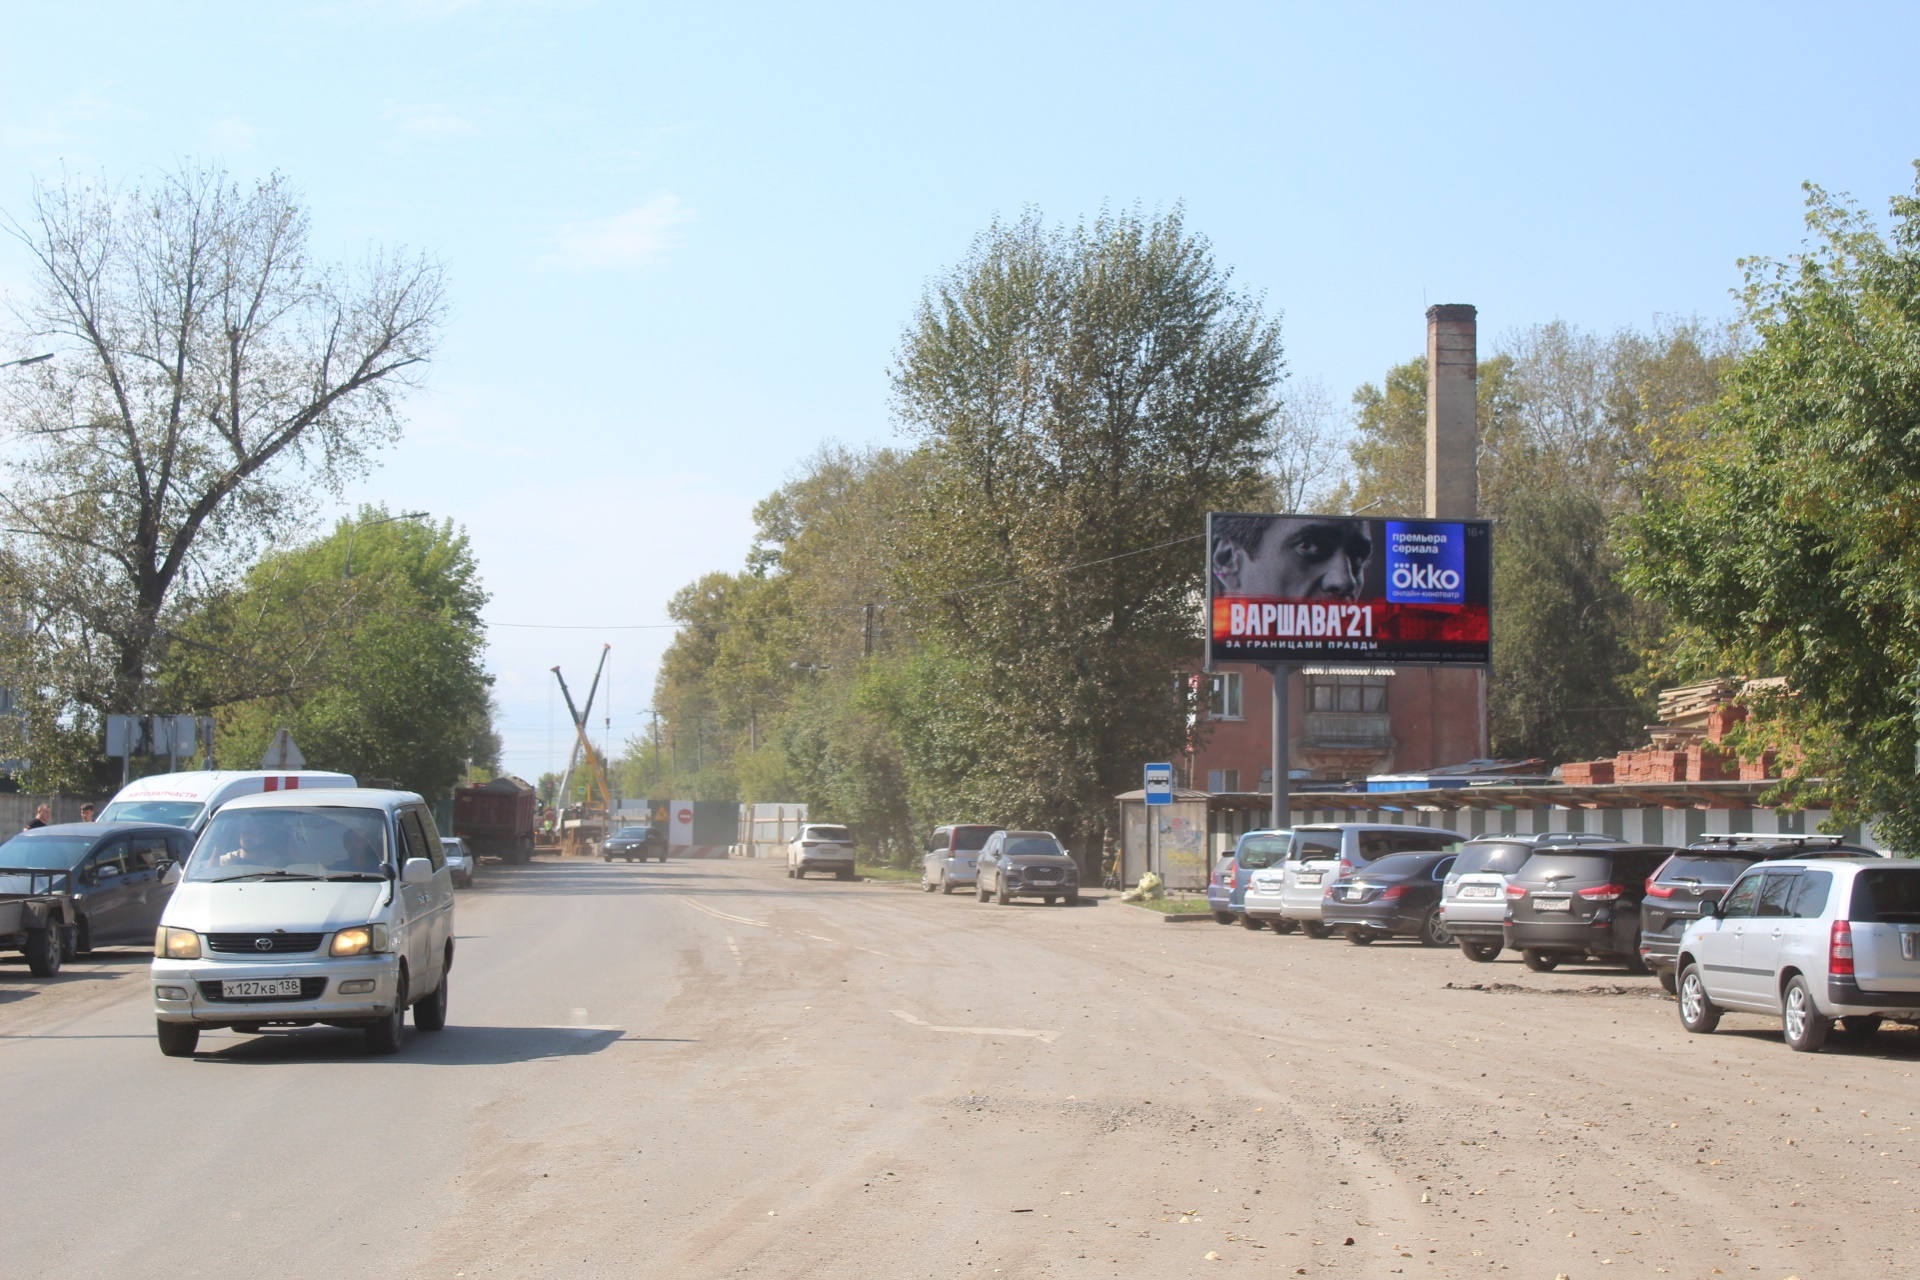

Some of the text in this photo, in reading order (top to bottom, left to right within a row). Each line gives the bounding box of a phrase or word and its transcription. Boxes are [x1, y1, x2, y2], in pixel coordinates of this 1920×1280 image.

[1467, 527, 1485, 537] 16+
[1392, 533, 1447, 544] премьера
[1392, 544, 1439, 555] сериала
[1392, 590, 1460, 599] онлайн-кинотеатр
[1230, 603, 1372, 637] ВАРШАВА'21
[1226, 640, 1378, 650] ЗА ГРАНИЦАМИ ПРАВДЫ
[128, 790, 199, 799] АВТОЗАПЧАСТИ
[227, 980, 298, 995] Х127КВ 138
